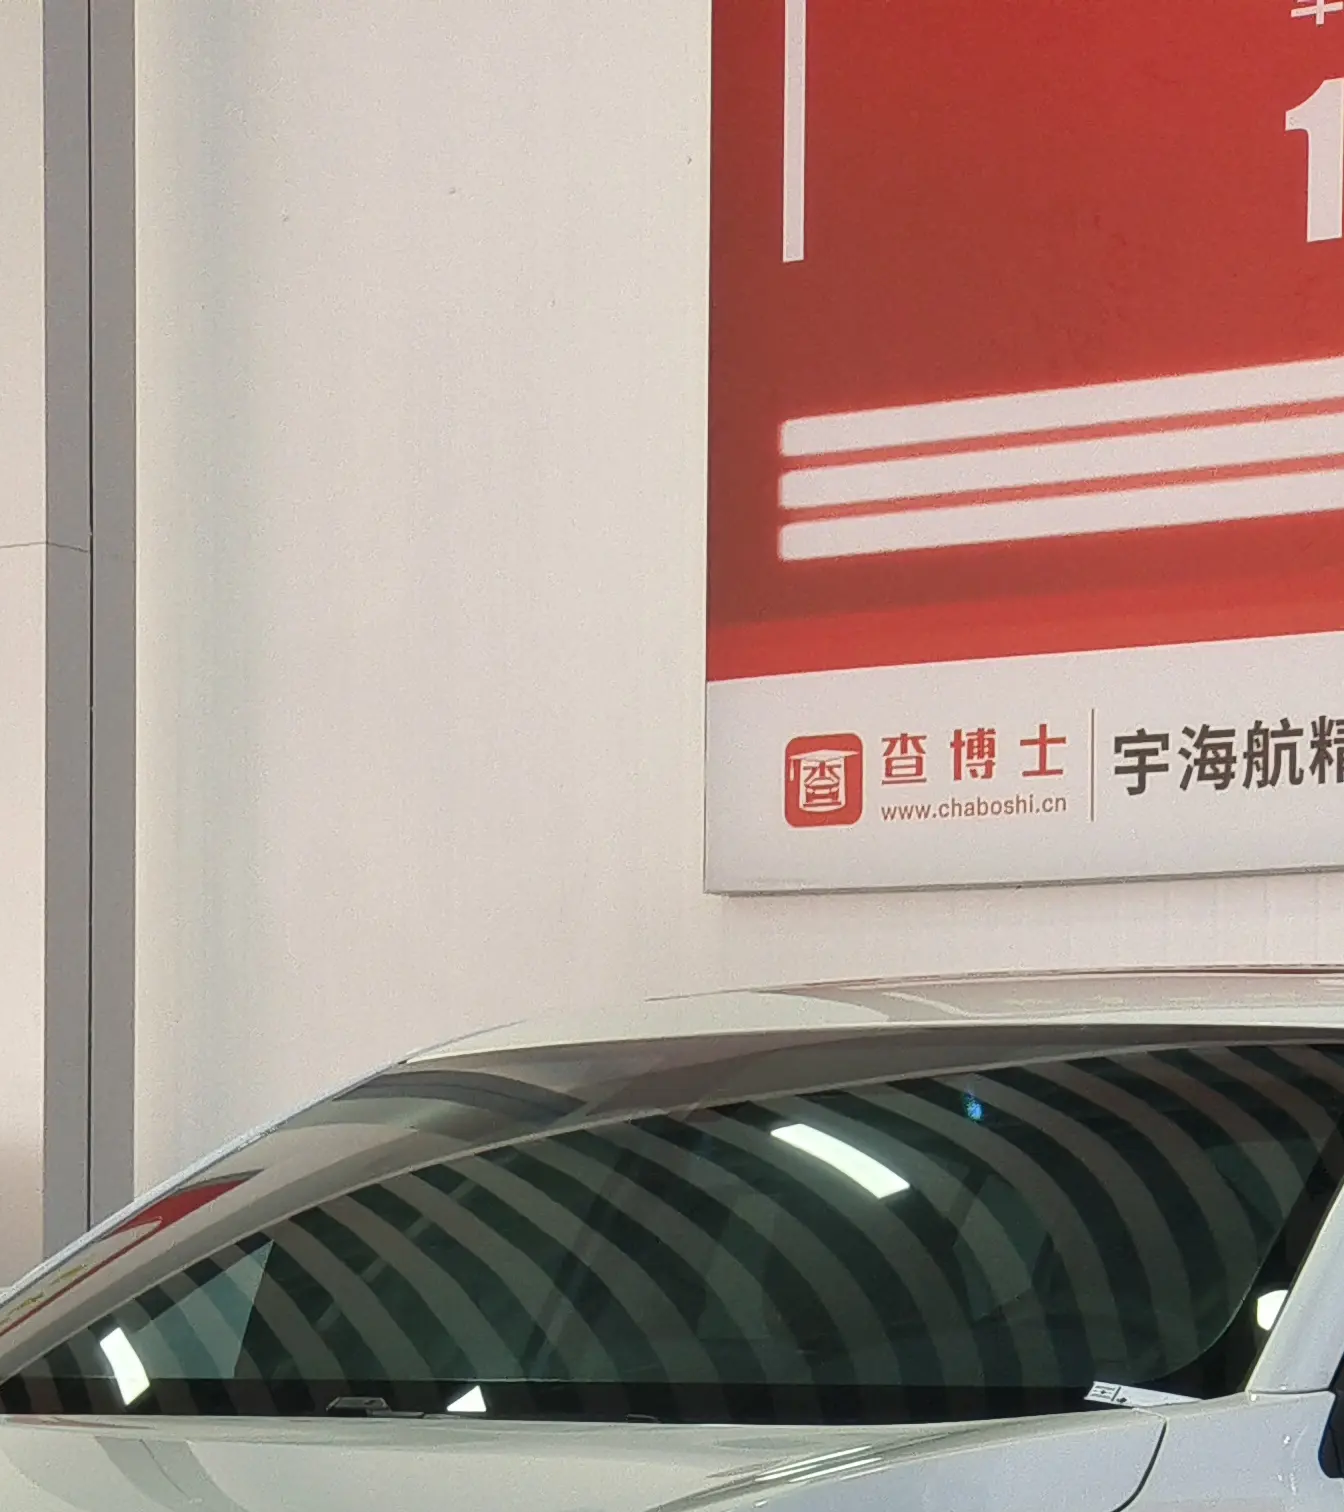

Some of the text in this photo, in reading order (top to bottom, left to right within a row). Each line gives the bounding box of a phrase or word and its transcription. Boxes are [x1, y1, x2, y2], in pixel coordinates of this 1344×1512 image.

[881, 723, 1067, 785] 查博士
[881, 794, 1067, 821] www.chaboshi.cn
